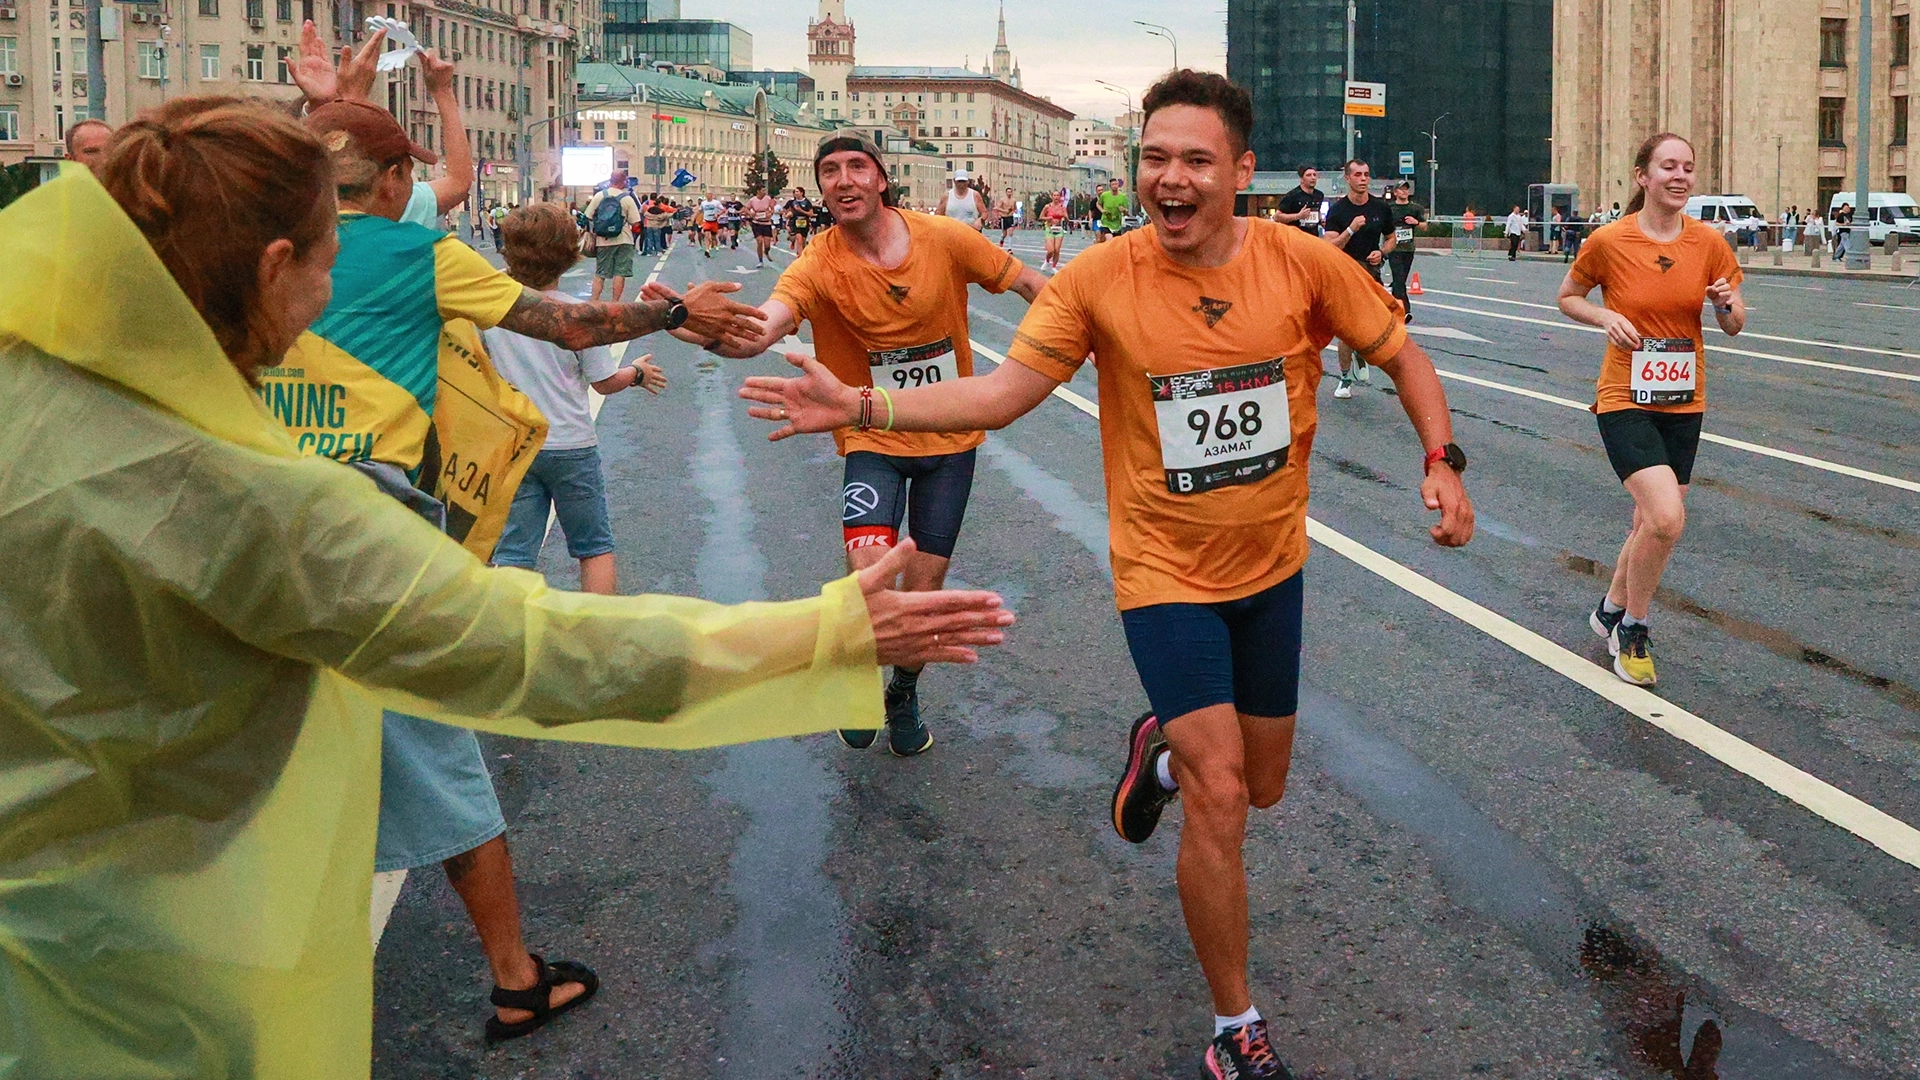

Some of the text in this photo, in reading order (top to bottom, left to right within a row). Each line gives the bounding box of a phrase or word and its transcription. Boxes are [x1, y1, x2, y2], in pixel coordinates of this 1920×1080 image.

[586, 110, 637, 121] FITNESS
[892, 365, 942, 389] 990
[1641, 361, 1691, 382] 6364
[1215, 381, 1236, 394] 15
[1639, 390, 1649, 402] D
[1187, 401, 1262, 445] 968
[1204, 440, 1252, 458] АЗАМАТ
[1177, 472, 1194, 492] B
